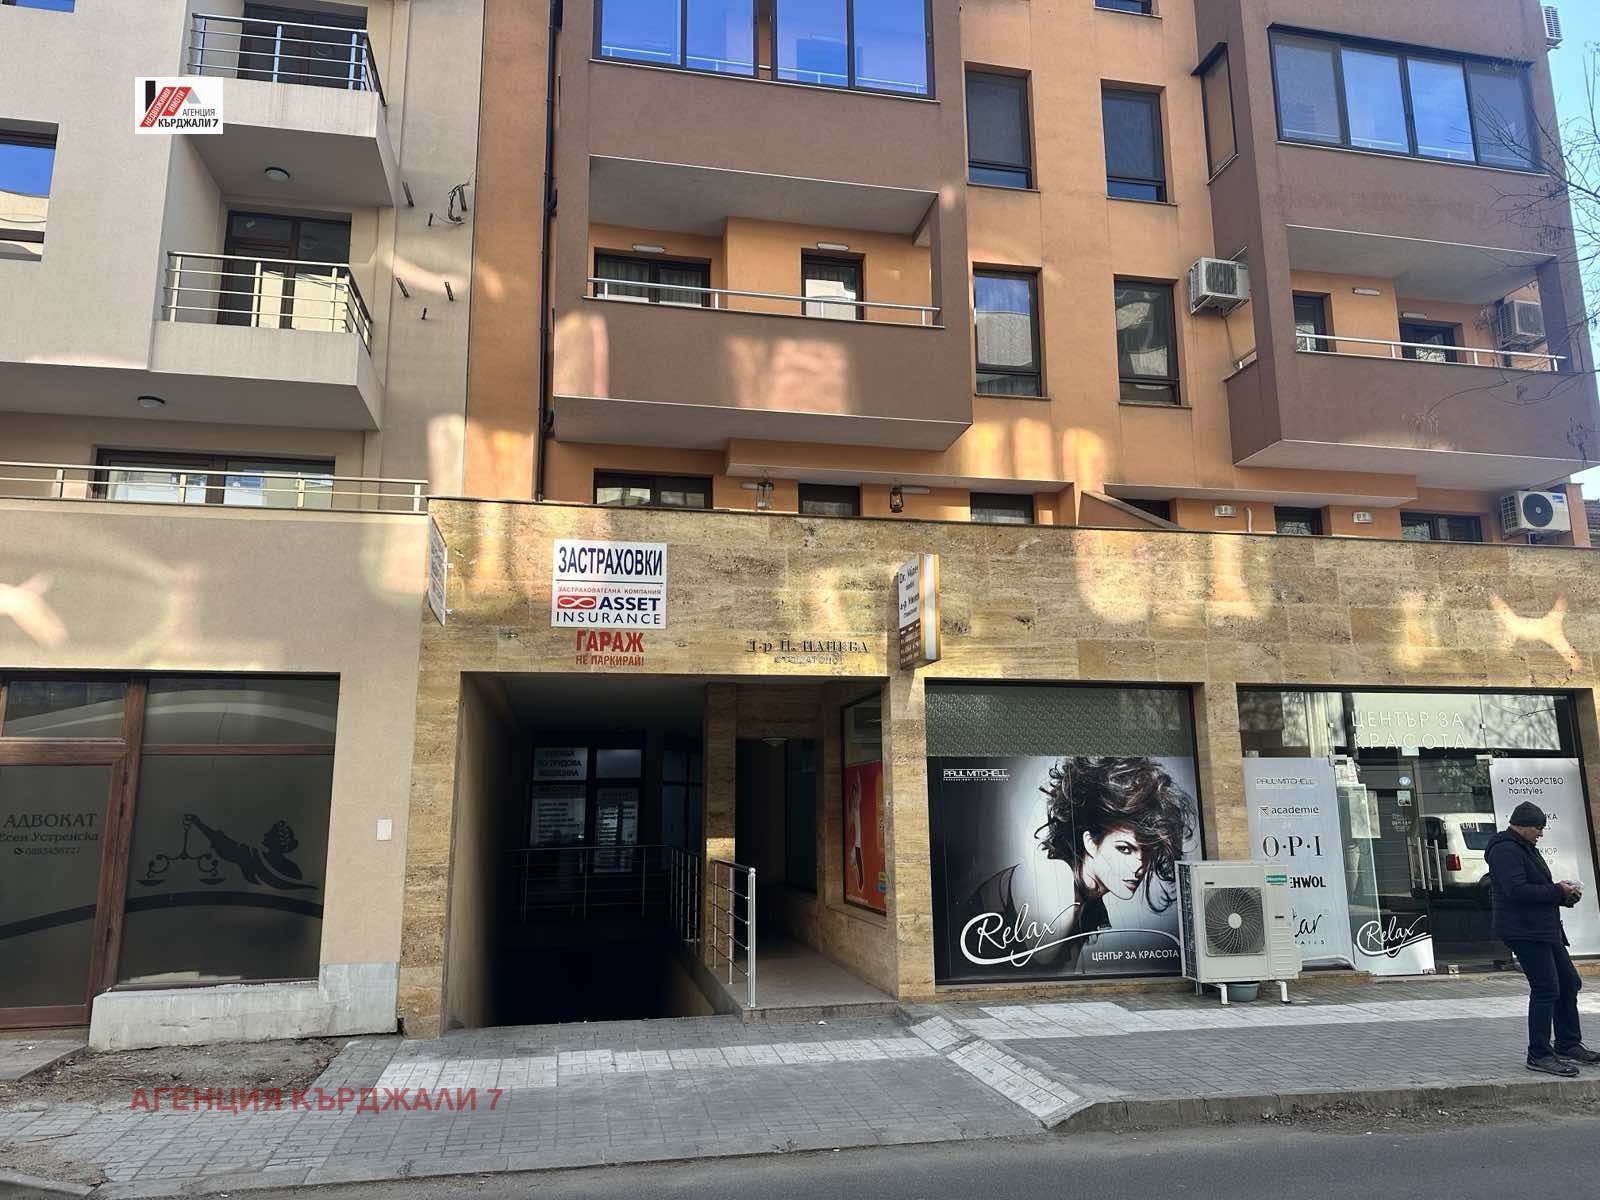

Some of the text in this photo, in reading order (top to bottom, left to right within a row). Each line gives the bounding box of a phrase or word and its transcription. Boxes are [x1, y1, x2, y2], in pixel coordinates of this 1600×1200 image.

[558, 546, 663, 576] ЗАСТРАХОВКИ
[558, 586, 622, 595] ЗАСТРАХОВАТЕЛНА
[598, 596, 661, 611] ASSET
[556, 611, 661, 625] INSURANCE
[576, 629, 645, 653] ГАРАЖ
[575, 654, 645, 667] НЕ ПАРКИРАЙ!
[1351, 711, 1465, 729] ЦЕНТЪР ЗА
[1353, 733, 1468, 750] КРАСОТА
[943, 769, 1010, 778] PAUL MITCHELL
[1507, 777, 1564, 785] ФРИЗЬОРСТВО
[1508, 787, 1543, 795] hairstyles
[4, 813, 98, 829] АДВОКАТ
[961, 903, 1080, 967] Relax
[1357, 915, 1428, 957] Relax
[1092, 949, 1180, 962] ЦЕНТЪР ЗА КРАСОТА
